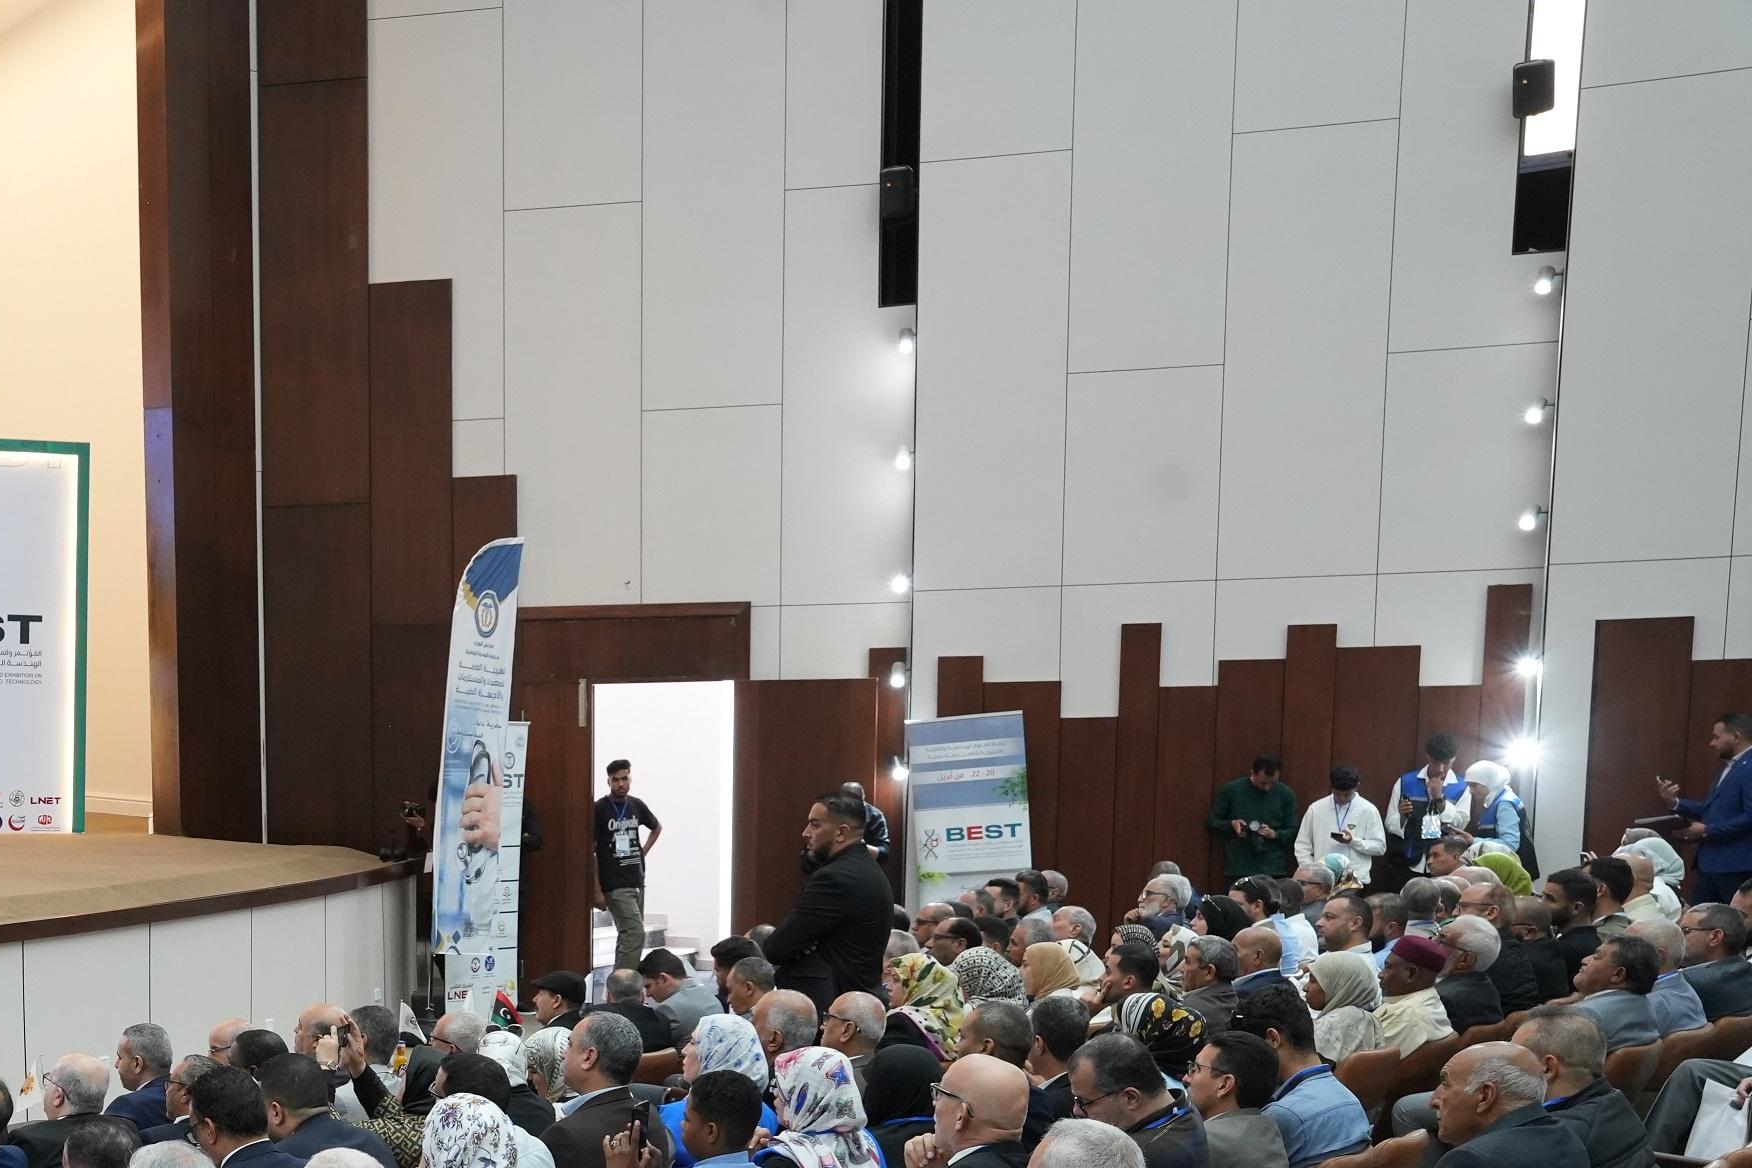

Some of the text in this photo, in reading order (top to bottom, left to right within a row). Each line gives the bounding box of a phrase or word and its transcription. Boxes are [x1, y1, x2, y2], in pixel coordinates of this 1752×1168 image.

[14, 649, 42, 658] المؤتمر
[7, 660, 42, 669] الهندسة
[30, 796, 62, 805] LNET
[945, 823, 1022, 842] BEST
[448, 989, 469, 1001] LNE
